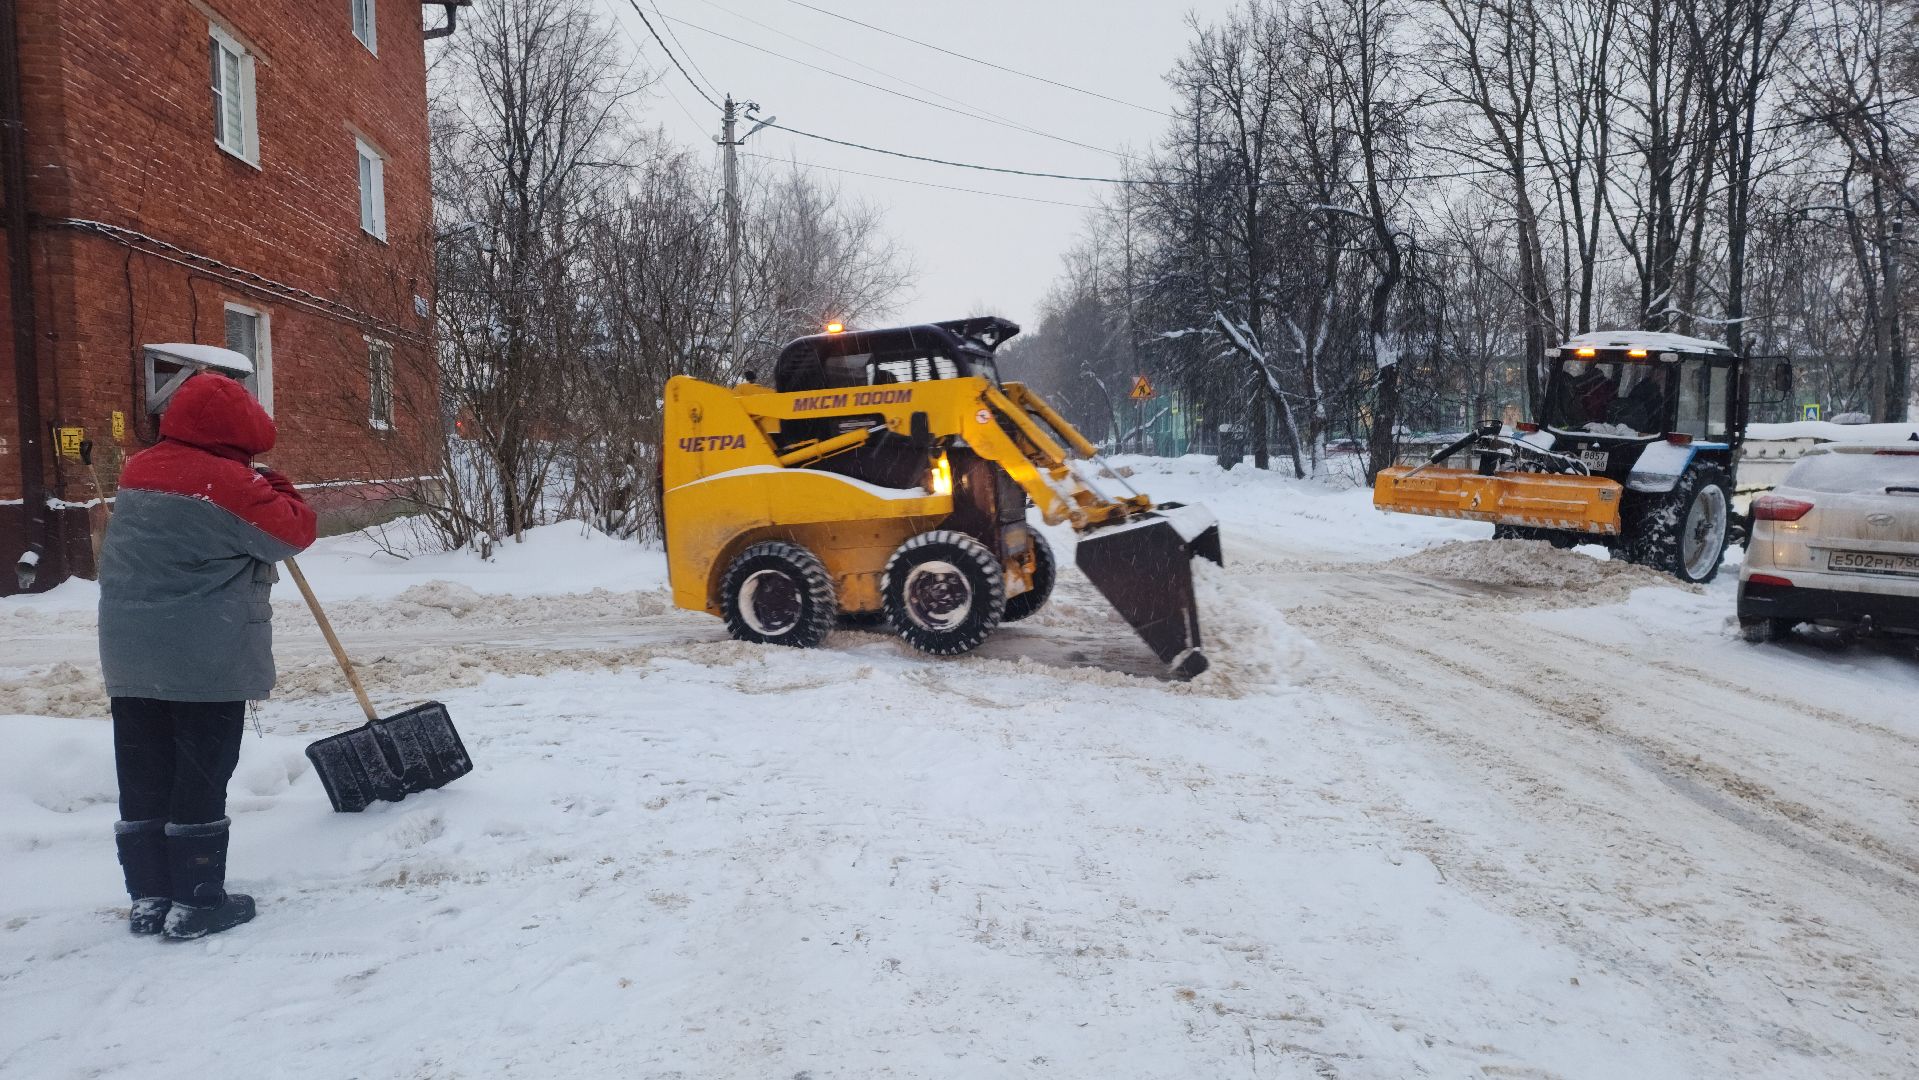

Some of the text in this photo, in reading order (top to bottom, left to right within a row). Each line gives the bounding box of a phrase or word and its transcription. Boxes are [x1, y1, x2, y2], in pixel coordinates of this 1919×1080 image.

[793, 388, 912, 412] МКСМ 1000М
[679, 434, 747, 452] ЧЕТРА
[1834, 554, 1895, 568] Е502РН
